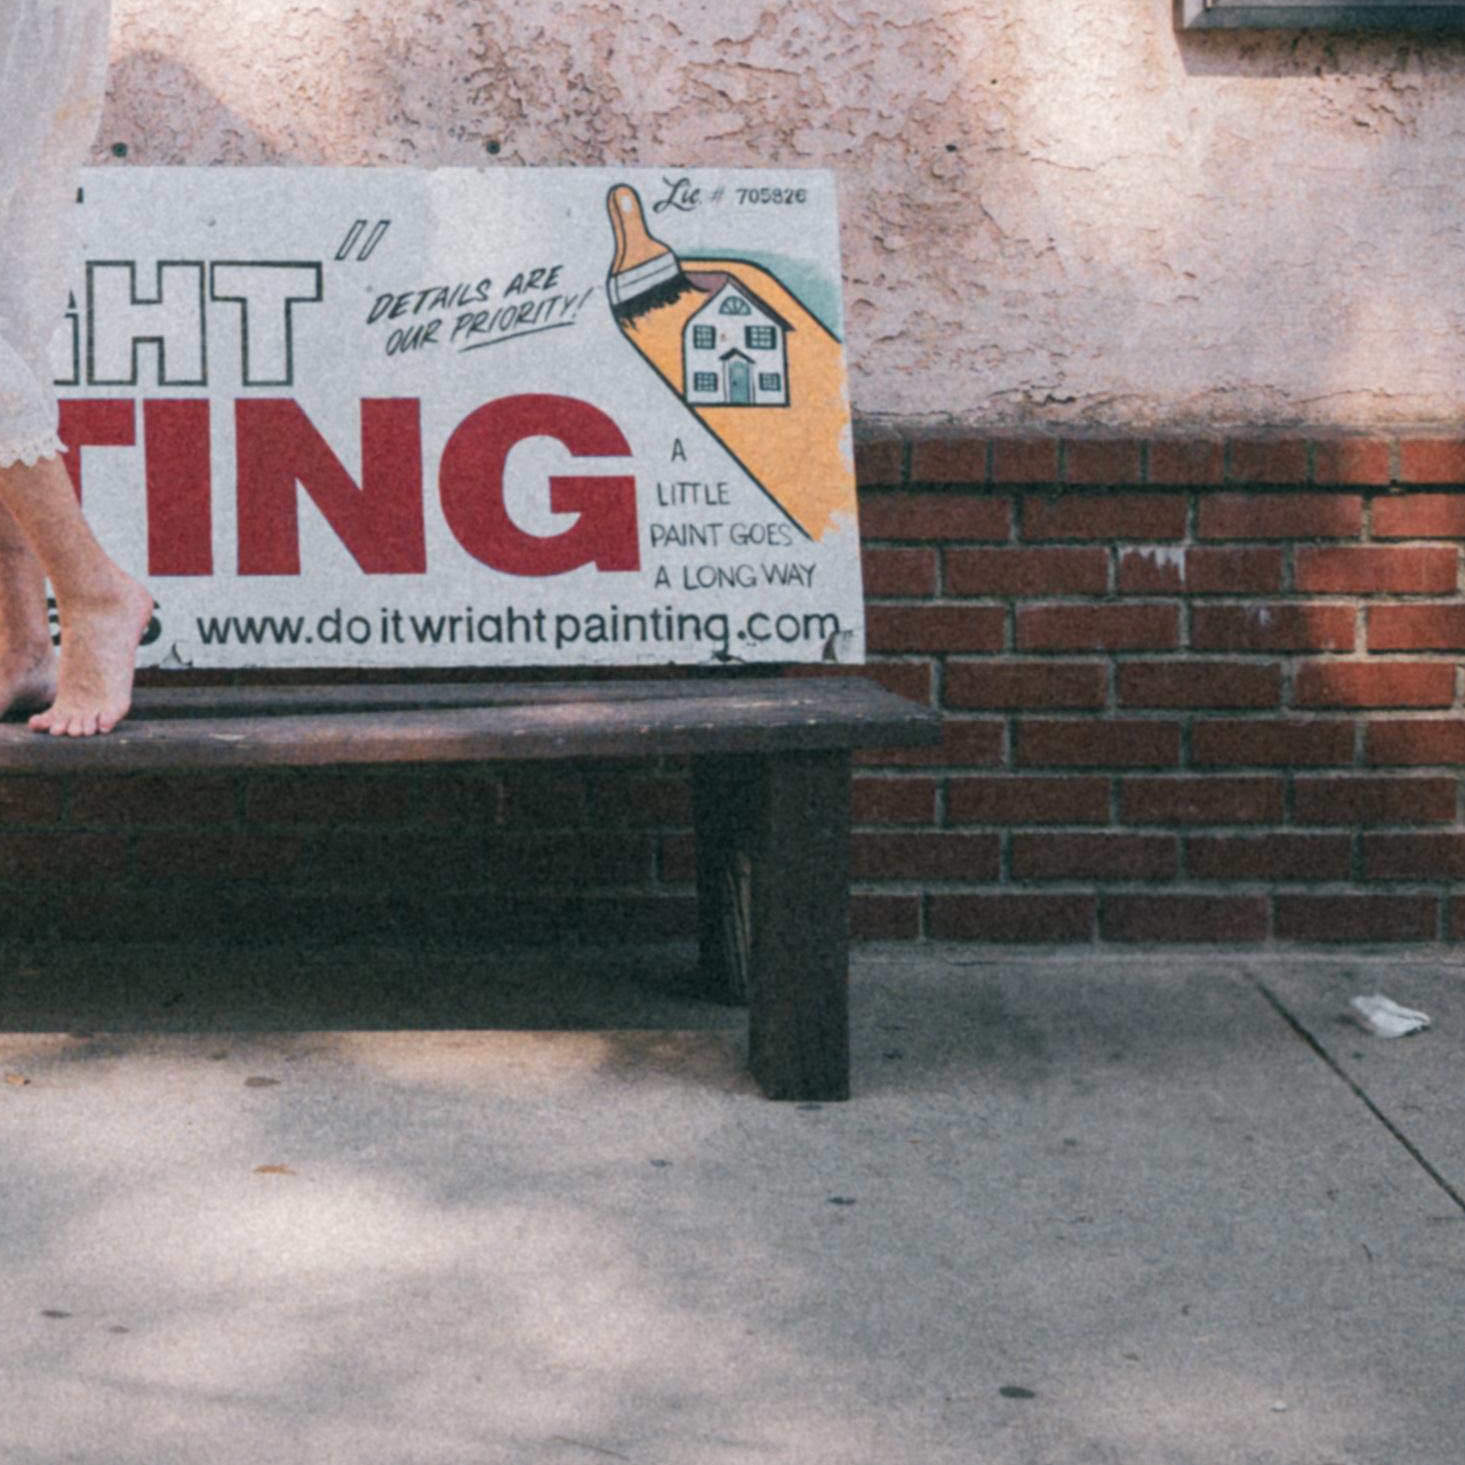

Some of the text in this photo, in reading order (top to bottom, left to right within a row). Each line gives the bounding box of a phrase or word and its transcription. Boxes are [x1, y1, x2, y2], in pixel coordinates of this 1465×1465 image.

[366, 264, 564, 324] DETAILS ARE
[386, 286, 594, 356] OUR PRIORITY!
[671, 437, 688, 463] A
[656, 481, 731, 507] LITTLE
[649, 521, 793, 548] PAINT GOES
[654, 562, 818, 591] A LONG WAY
